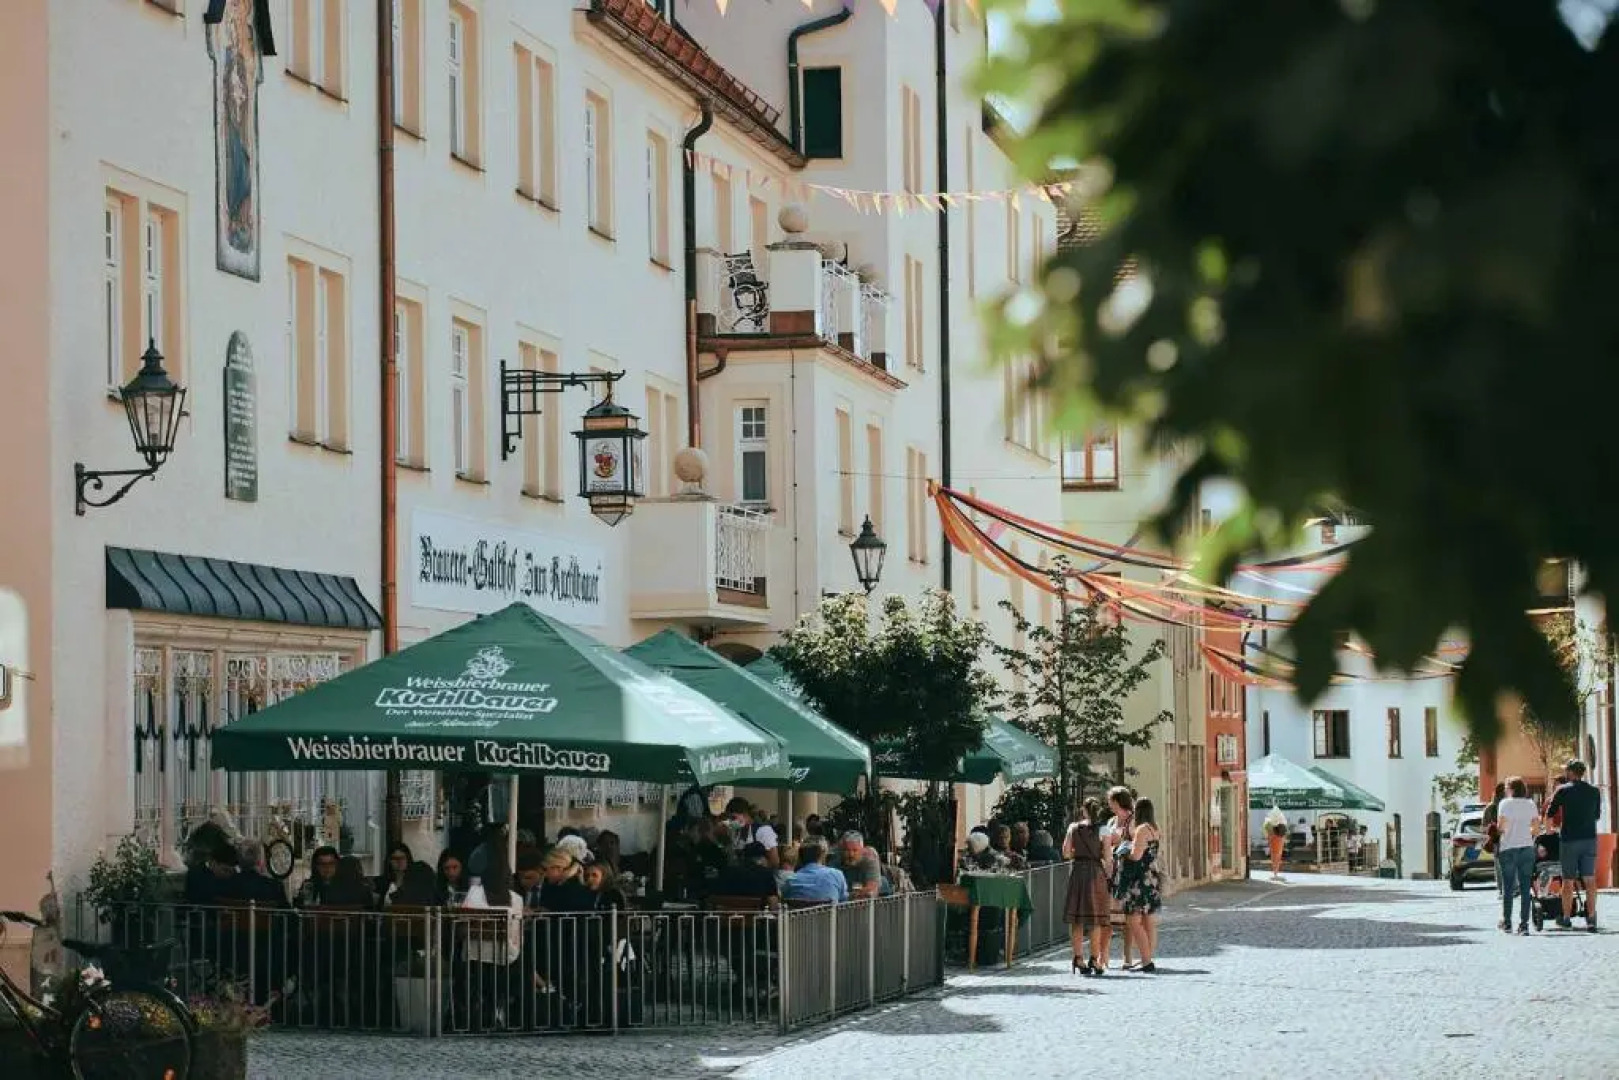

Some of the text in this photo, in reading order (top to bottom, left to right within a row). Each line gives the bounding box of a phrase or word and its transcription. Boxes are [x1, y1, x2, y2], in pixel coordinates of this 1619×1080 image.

[406, 676, 551, 692] Weissbierbrauer
[376, 687, 558, 713] Kuchlbauer
[287, 736, 611, 773] Weissbierbrauer Kuchlbauer
